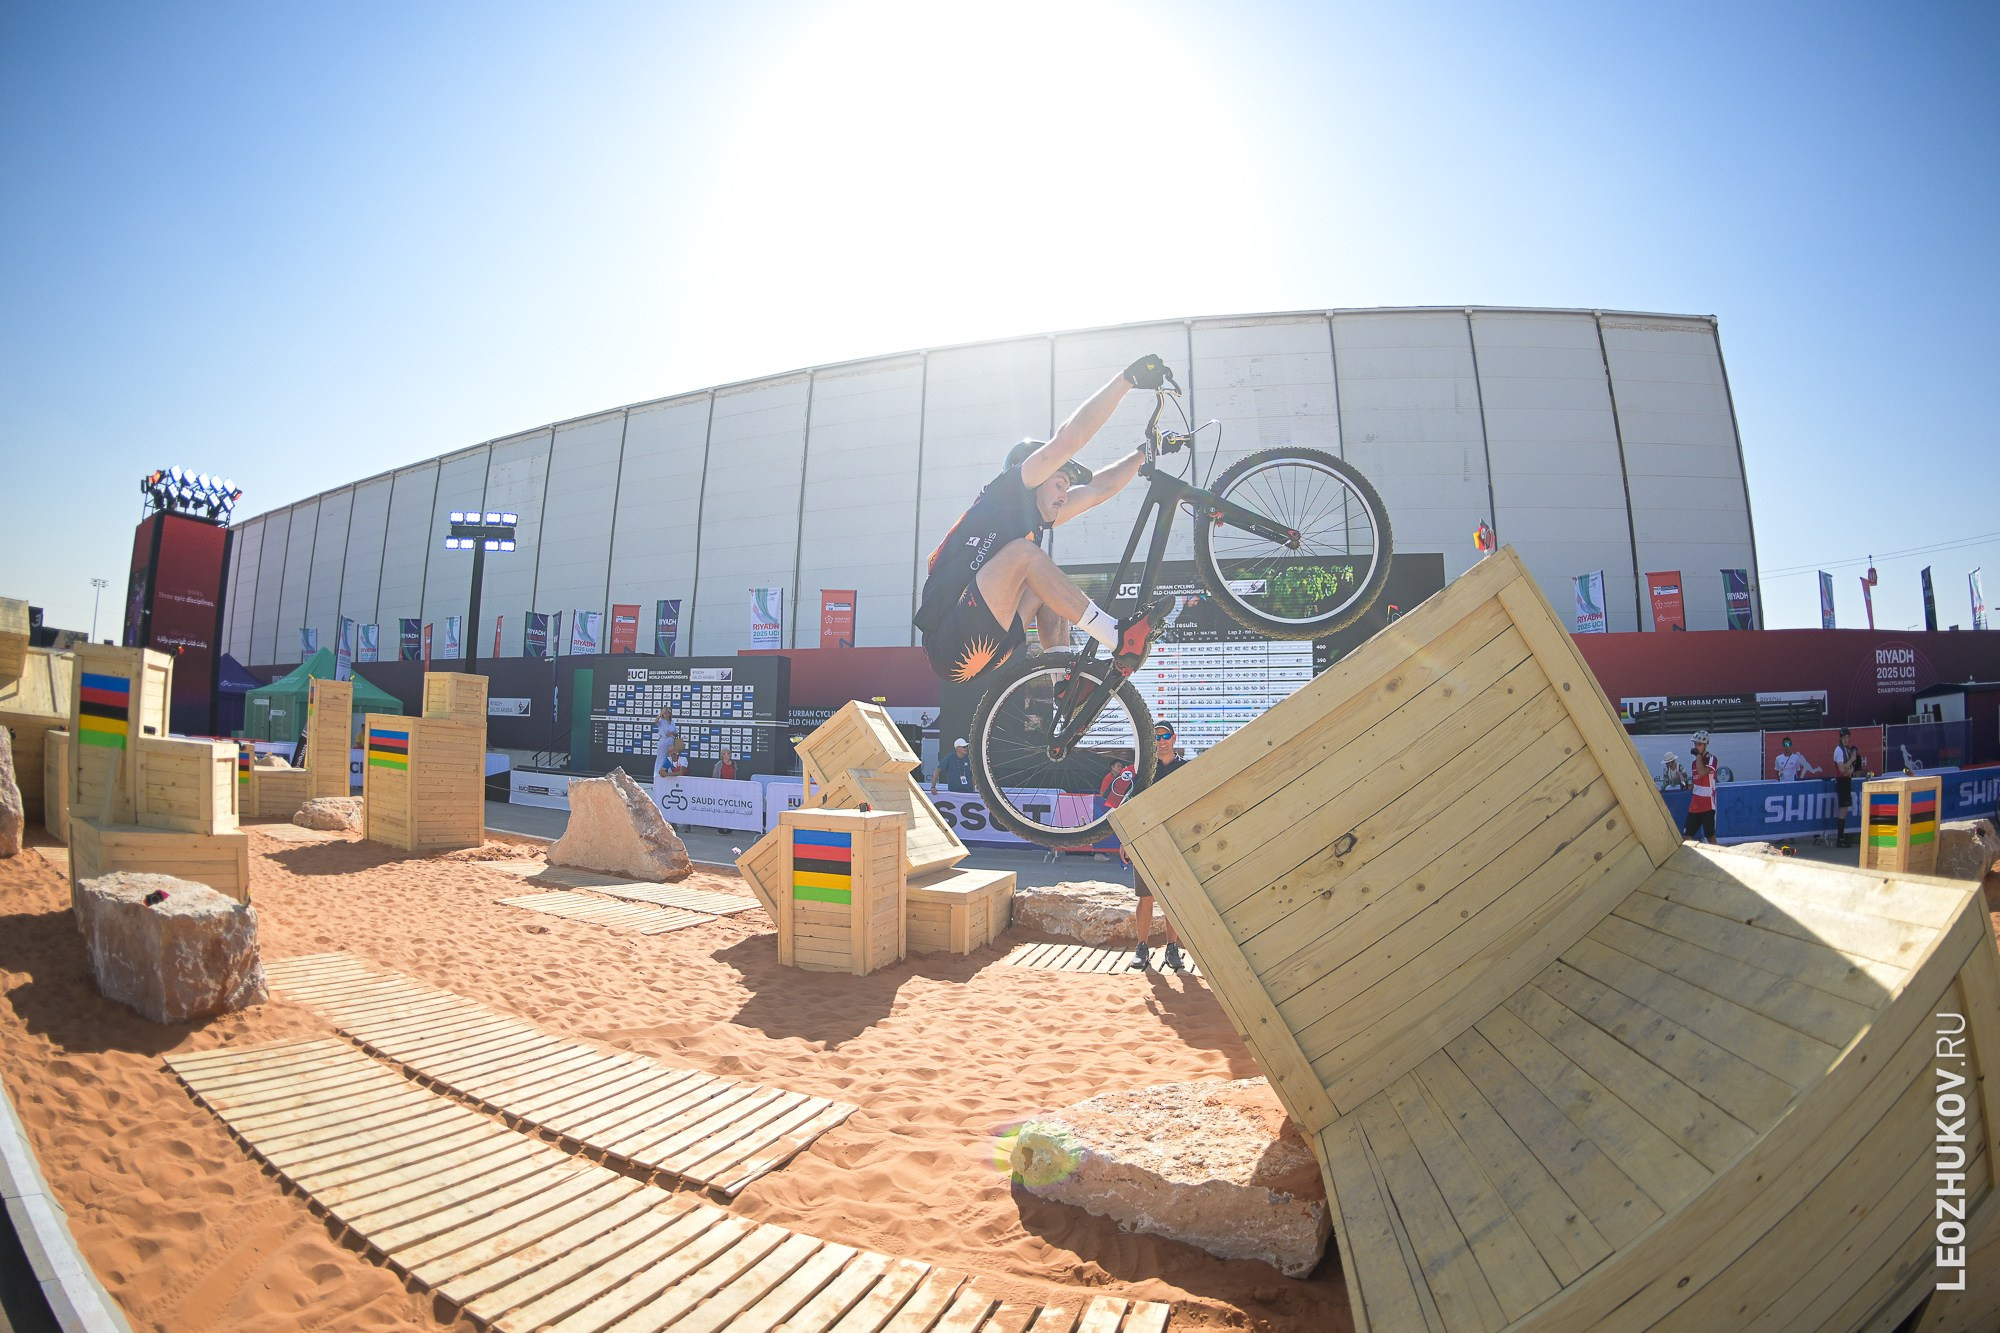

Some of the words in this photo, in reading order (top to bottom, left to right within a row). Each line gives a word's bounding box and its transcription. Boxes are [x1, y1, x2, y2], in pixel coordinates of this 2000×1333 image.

[969, 532, 997, 571] Cofidis
[1727, 592, 1748, 600] RIYADH
[1577, 612, 1603, 624] RIYADH
[527, 628, 546, 636] RIYADH
[573, 639, 596, 648] RIYADH
[1876, 649, 1914, 664] RIYADH
[631, 671, 646, 679] UCI
[1876, 667, 1898, 679] 2025
[1899, 666, 1915, 678] UCI
[1959, 778, 2000, 806] SHI
[691, 796, 716, 805] SAUDI
[717, 798, 753, 809] CYCLING
[1764, 791, 1862, 823] SHIMA
[933, 800, 1052, 832] SST
